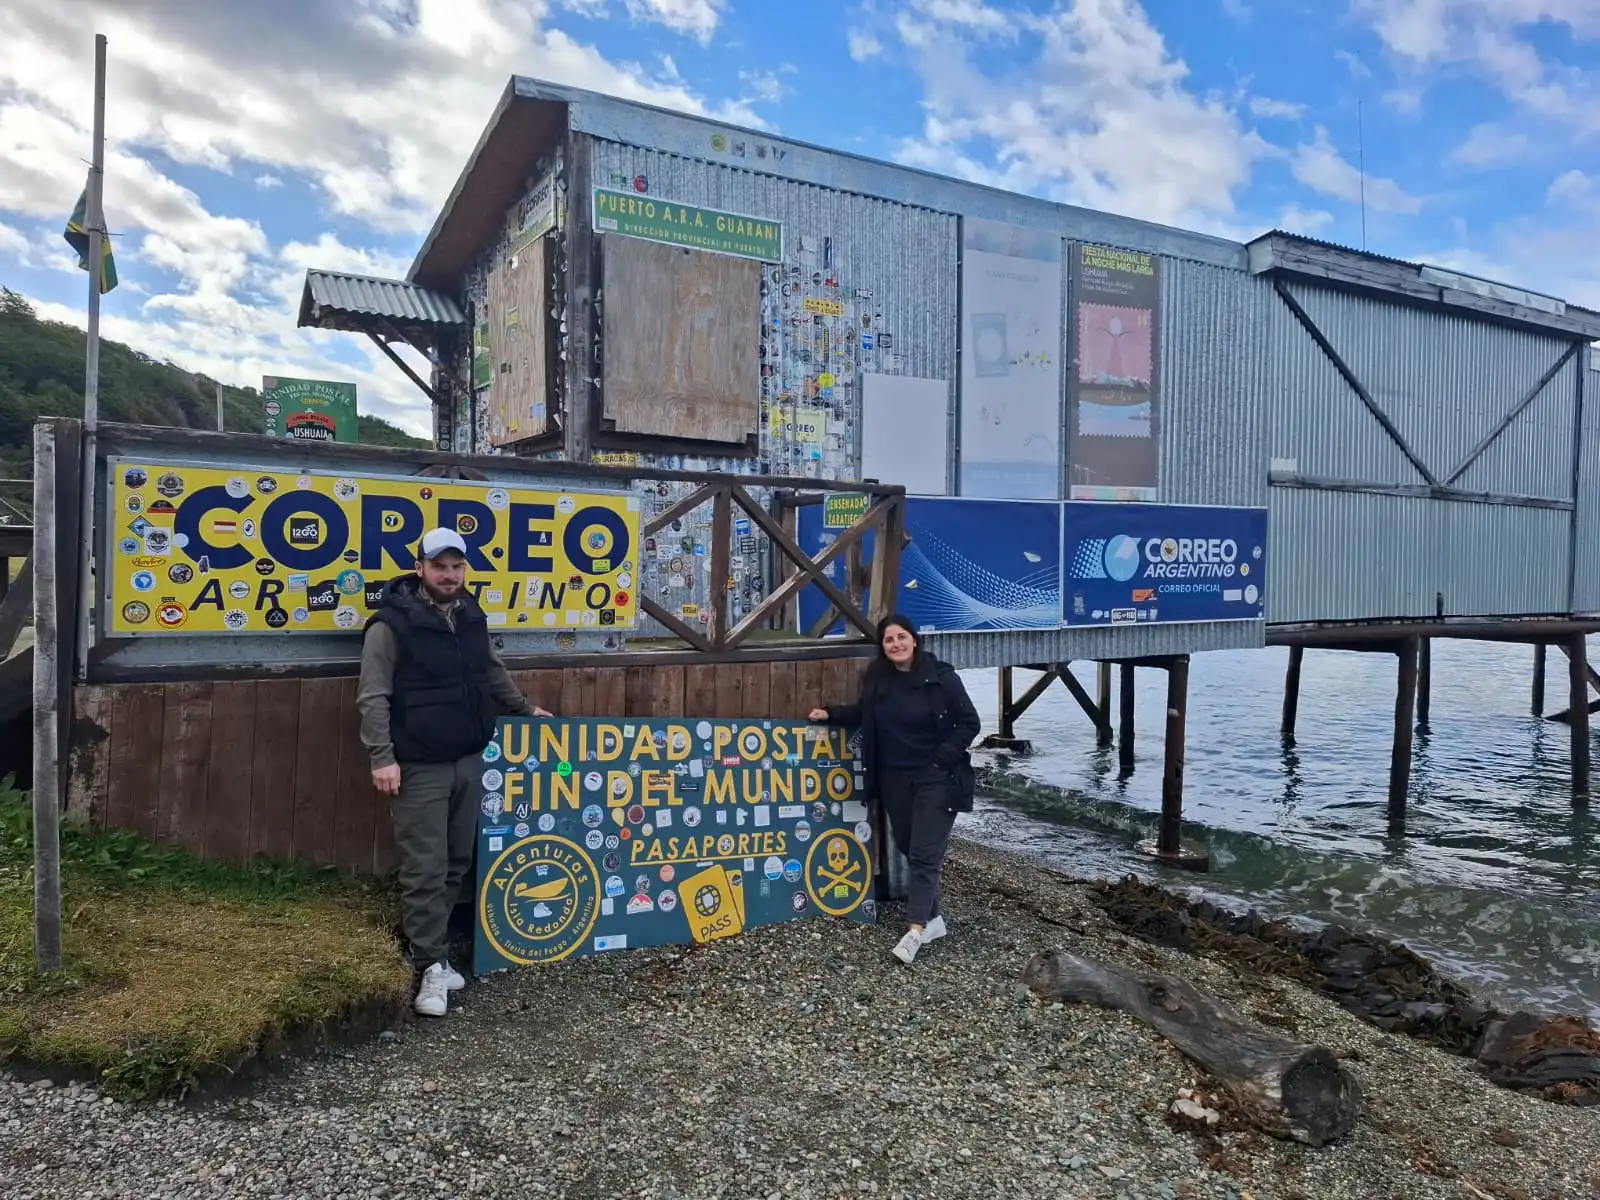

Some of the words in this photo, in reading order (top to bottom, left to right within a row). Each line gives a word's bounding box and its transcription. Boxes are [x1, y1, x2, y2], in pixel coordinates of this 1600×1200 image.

[599, 193, 655, 218] PUERTO
[663, 206, 709, 229] A.R.A.
[716, 215, 778, 241] GUARANI
[673, 232, 719, 247] PROVINCIAL
[722, 241, 732, 249] DE
[734, 243, 766, 255] PUERTOS
[1081, 255, 1091, 266] LA
[1091, 257, 1116, 270] NOCHE
[1132, 264, 1154, 276] LARGA
[1082, 246, 1105, 259] FIESTA
[1106, 250, 1140, 264] NACIONAL
[1141, 256, 1151, 265] DE
[271, 383, 310, 399] UNIDAD
[315, 384, 352, 406] POSTAL
[294, 428, 328, 438] USHUAIA
[830, 497, 864, 510] ENSENADA
[174, 485, 630, 576] CORREO
[292, 528, 317, 537] 12GO
[1145, 537, 1237, 563] CORREO
[1143, 563, 1236, 578] ARGENTINO
[189, 577, 611, 611] ARTINO
[309, 595, 333, 604] 12GO
[366, 591, 382, 600] 12G
[1158, 584, 1191, 593] CORREO
[1193, 584, 1221, 593] OFICIAL
[503, 724, 692, 763] UNIDAD
[713, 725, 855, 761] POSTAL
[504, 770, 580, 812] FIN
[607, 769, 684, 808] DEL
[703, 767, 854, 805] MUNDO
[630, 830, 787, 862] PASAPORTES
[493, 843, 588, 891] Aventuras
[509, 902, 524, 926] Isla
[527, 897, 573, 934] Redonda
[700, 914, 732, 940] PASS
